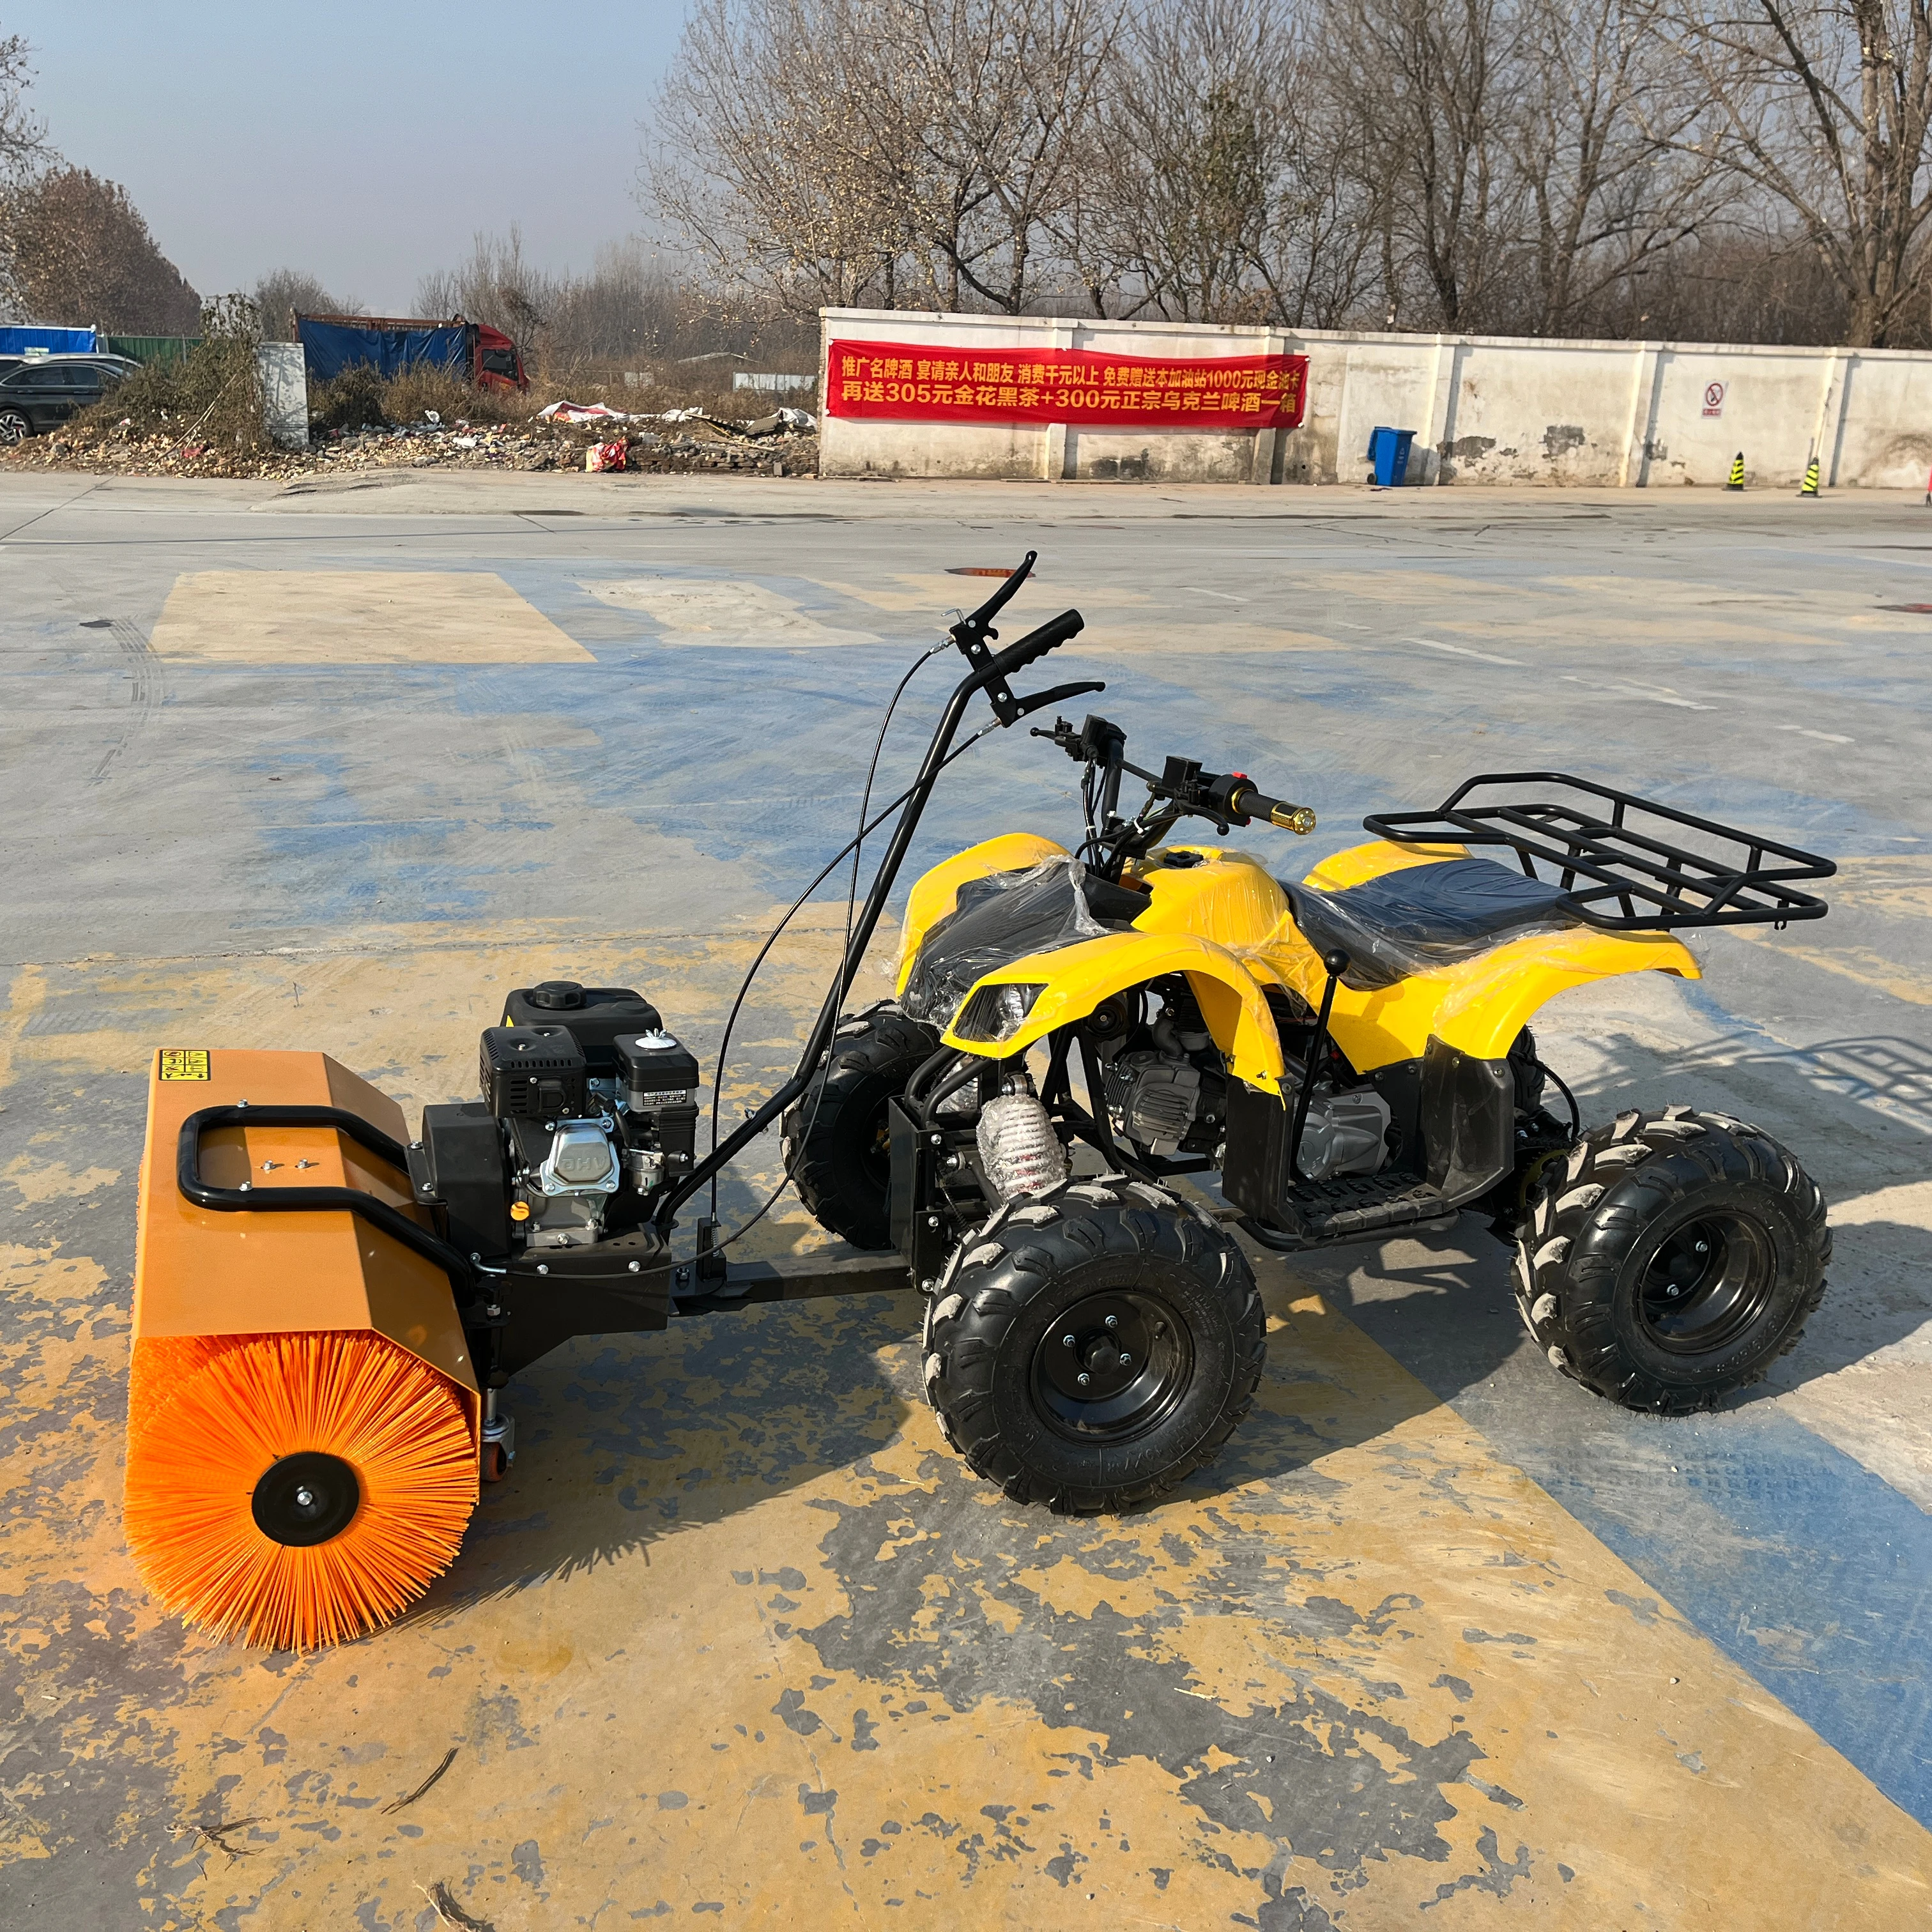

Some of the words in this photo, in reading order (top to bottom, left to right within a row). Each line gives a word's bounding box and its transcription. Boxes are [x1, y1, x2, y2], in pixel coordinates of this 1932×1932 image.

[841, 355, 914, 380] 推广名牌酒
[916, 359, 1015, 383] 宴请亲人和朋友
[1017, 363, 1100, 385] 消费千元以上
[841, 380, 1296, 413] 再送305元金花黑茶+300元正宗乌克兰啤酒一箱
[562, 1156, 607, 1171] OHV
